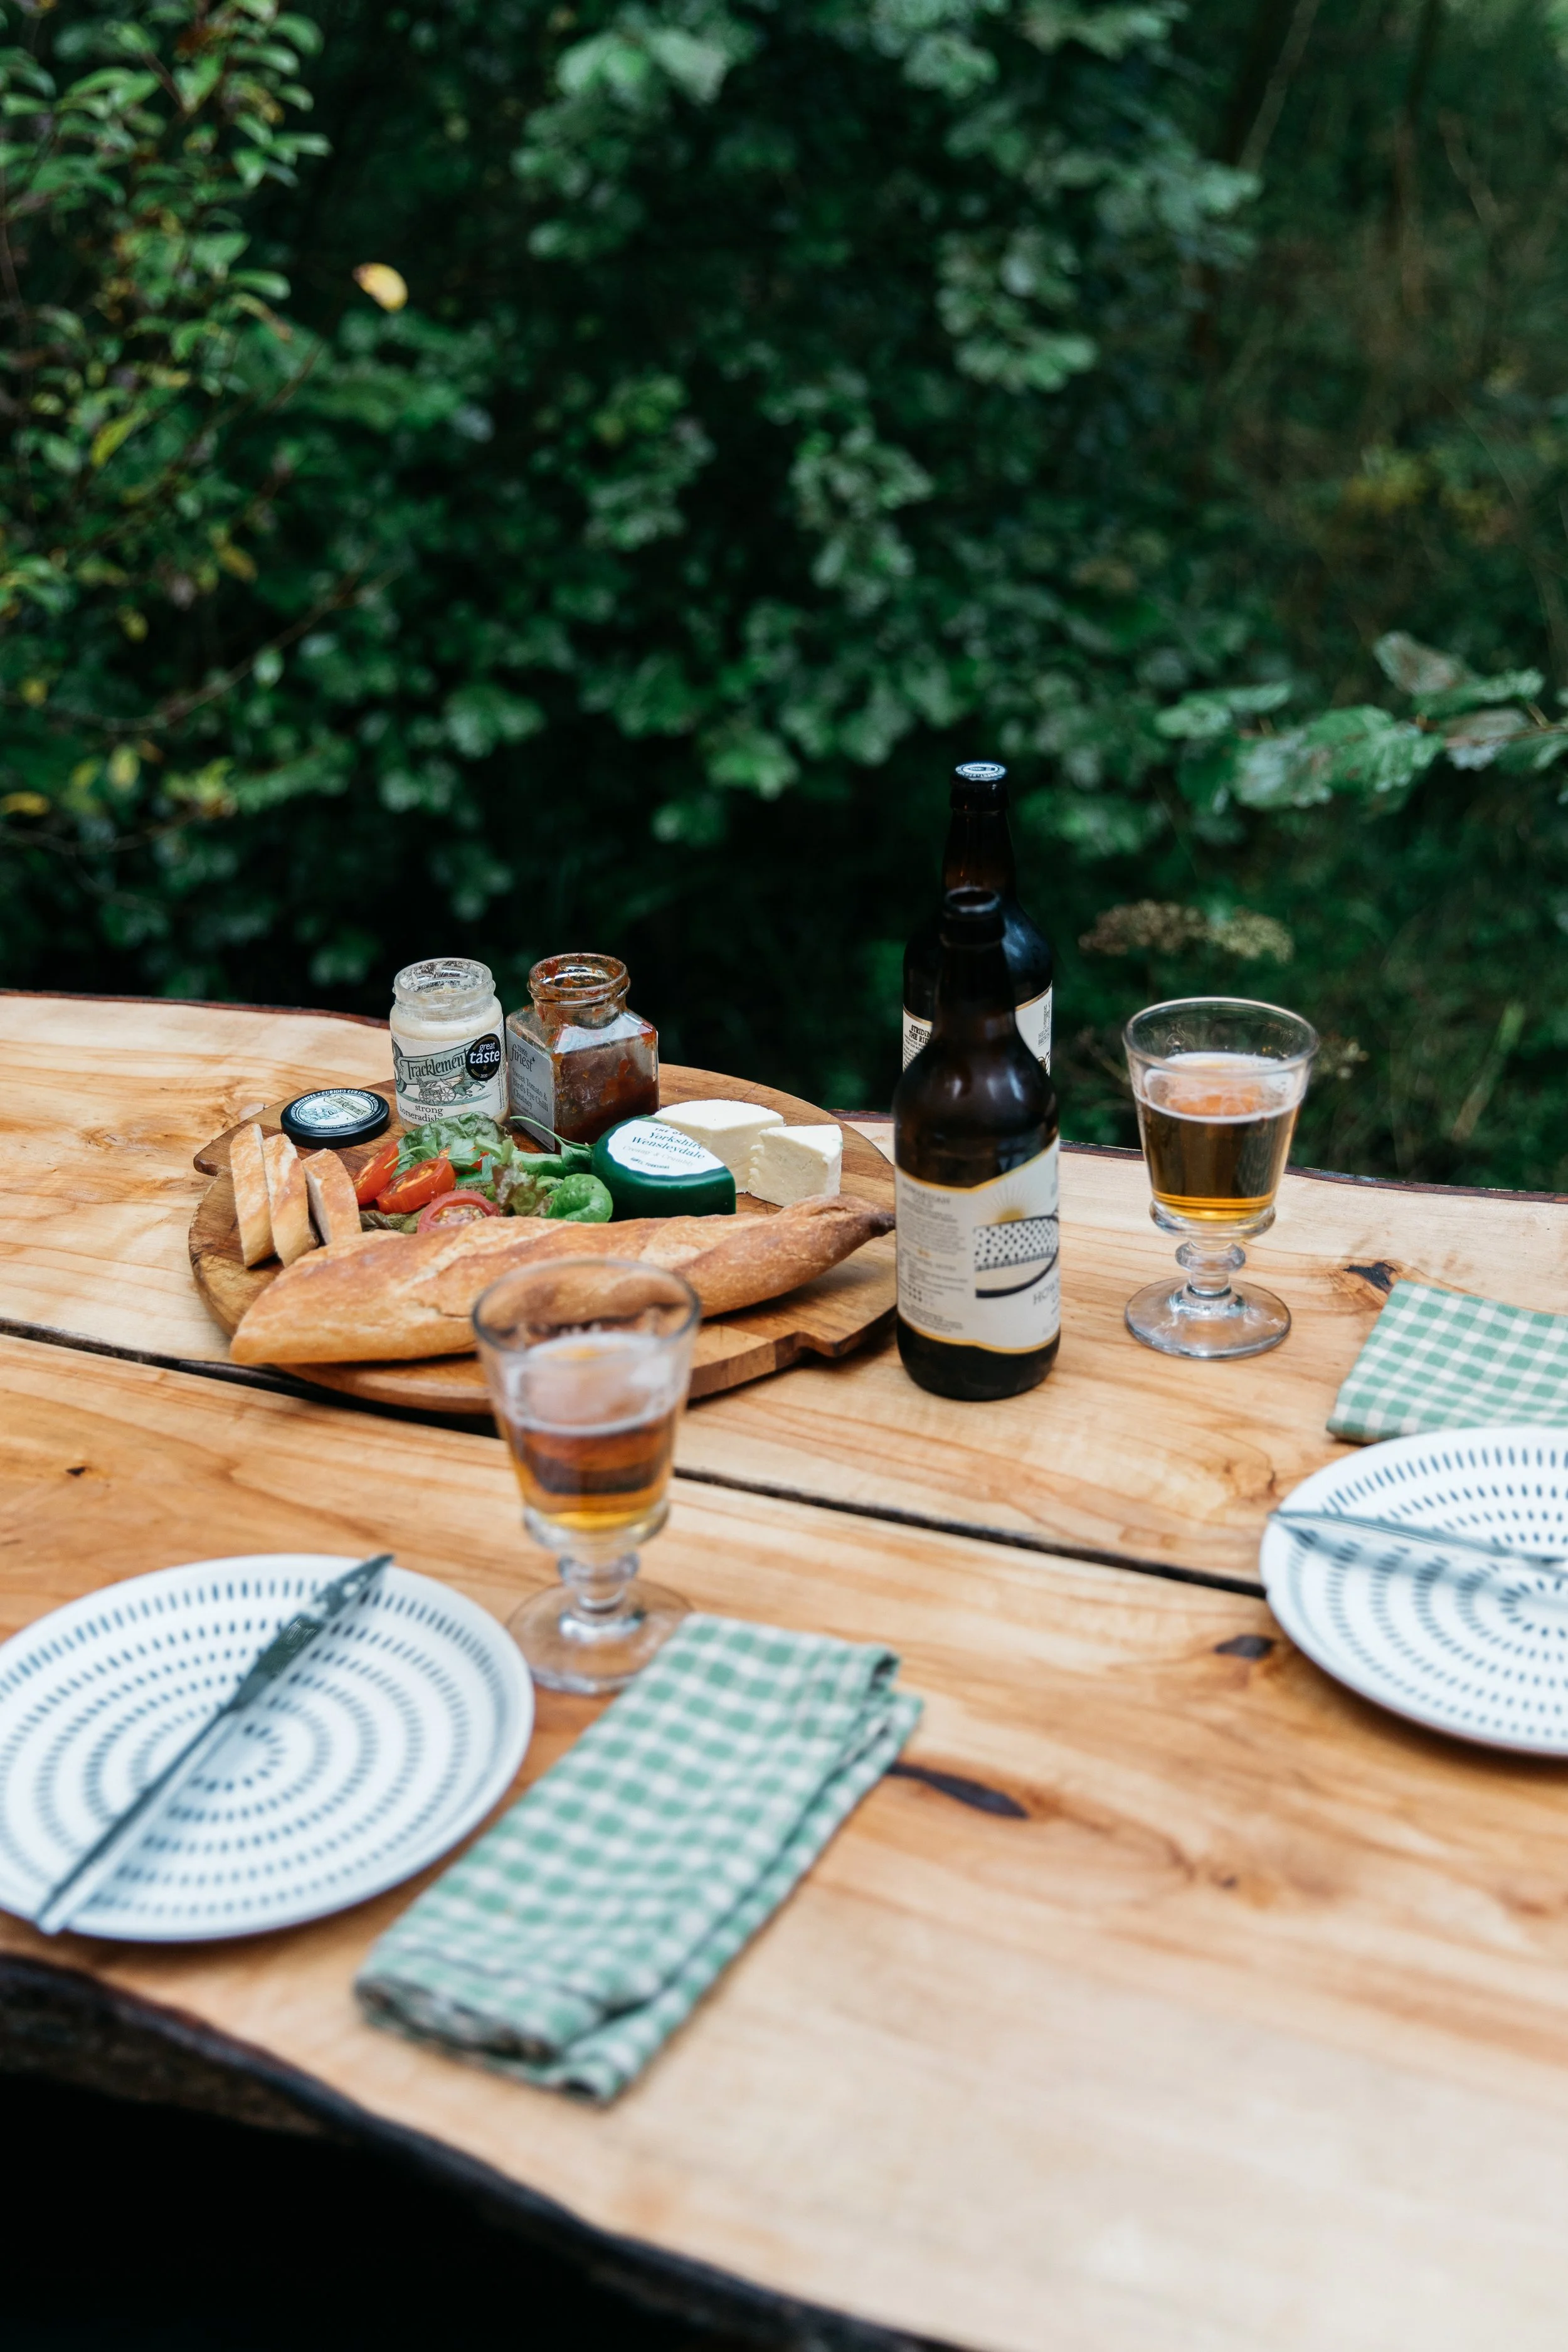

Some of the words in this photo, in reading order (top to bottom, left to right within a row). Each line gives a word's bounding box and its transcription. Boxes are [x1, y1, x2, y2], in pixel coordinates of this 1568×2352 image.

[909, 1030, 918, 1040] THE
[919, 1036, 929, 1044] RID
[911, 1024, 931, 1038] STRIDIN
[479, 1042, 495, 1052] great
[400, 1048, 468, 1080] Tracklement
[470, 1050, 501, 1064] taste
[510, 1044, 533, 1072] finest
[512, 1067, 526, 1083] Sweet
[526, 1078, 543, 1097] Tomato
[513, 1078, 526, 1094] Bird's
[527, 1088, 535, 1101] Eye
[535, 1096, 549, 1112] Chilli
[513, 1088, 532, 1110] Chutney
[400, 1103, 440, 1122] horseradish
[415, 1104, 443, 1116] strong
[632, 1136, 705, 1159] Wensleydale
[649, 1132, 704, 1150] Yorkshire
